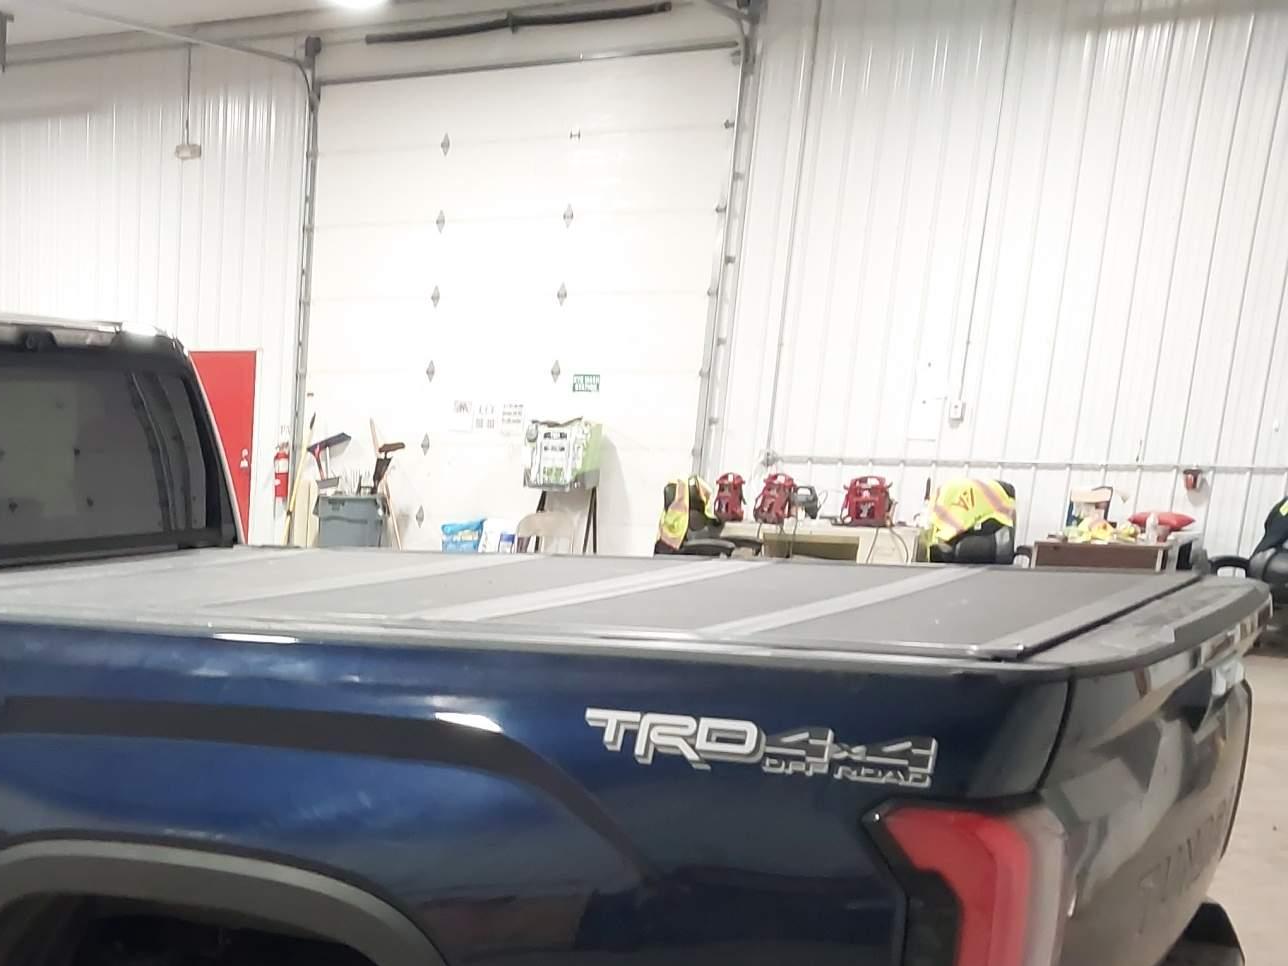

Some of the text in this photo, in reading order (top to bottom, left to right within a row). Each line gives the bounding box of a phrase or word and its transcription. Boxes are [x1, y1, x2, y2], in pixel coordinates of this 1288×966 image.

[585, 706, 766, 771] TRD
[762, 757, 932, 788] OFF ROAD
